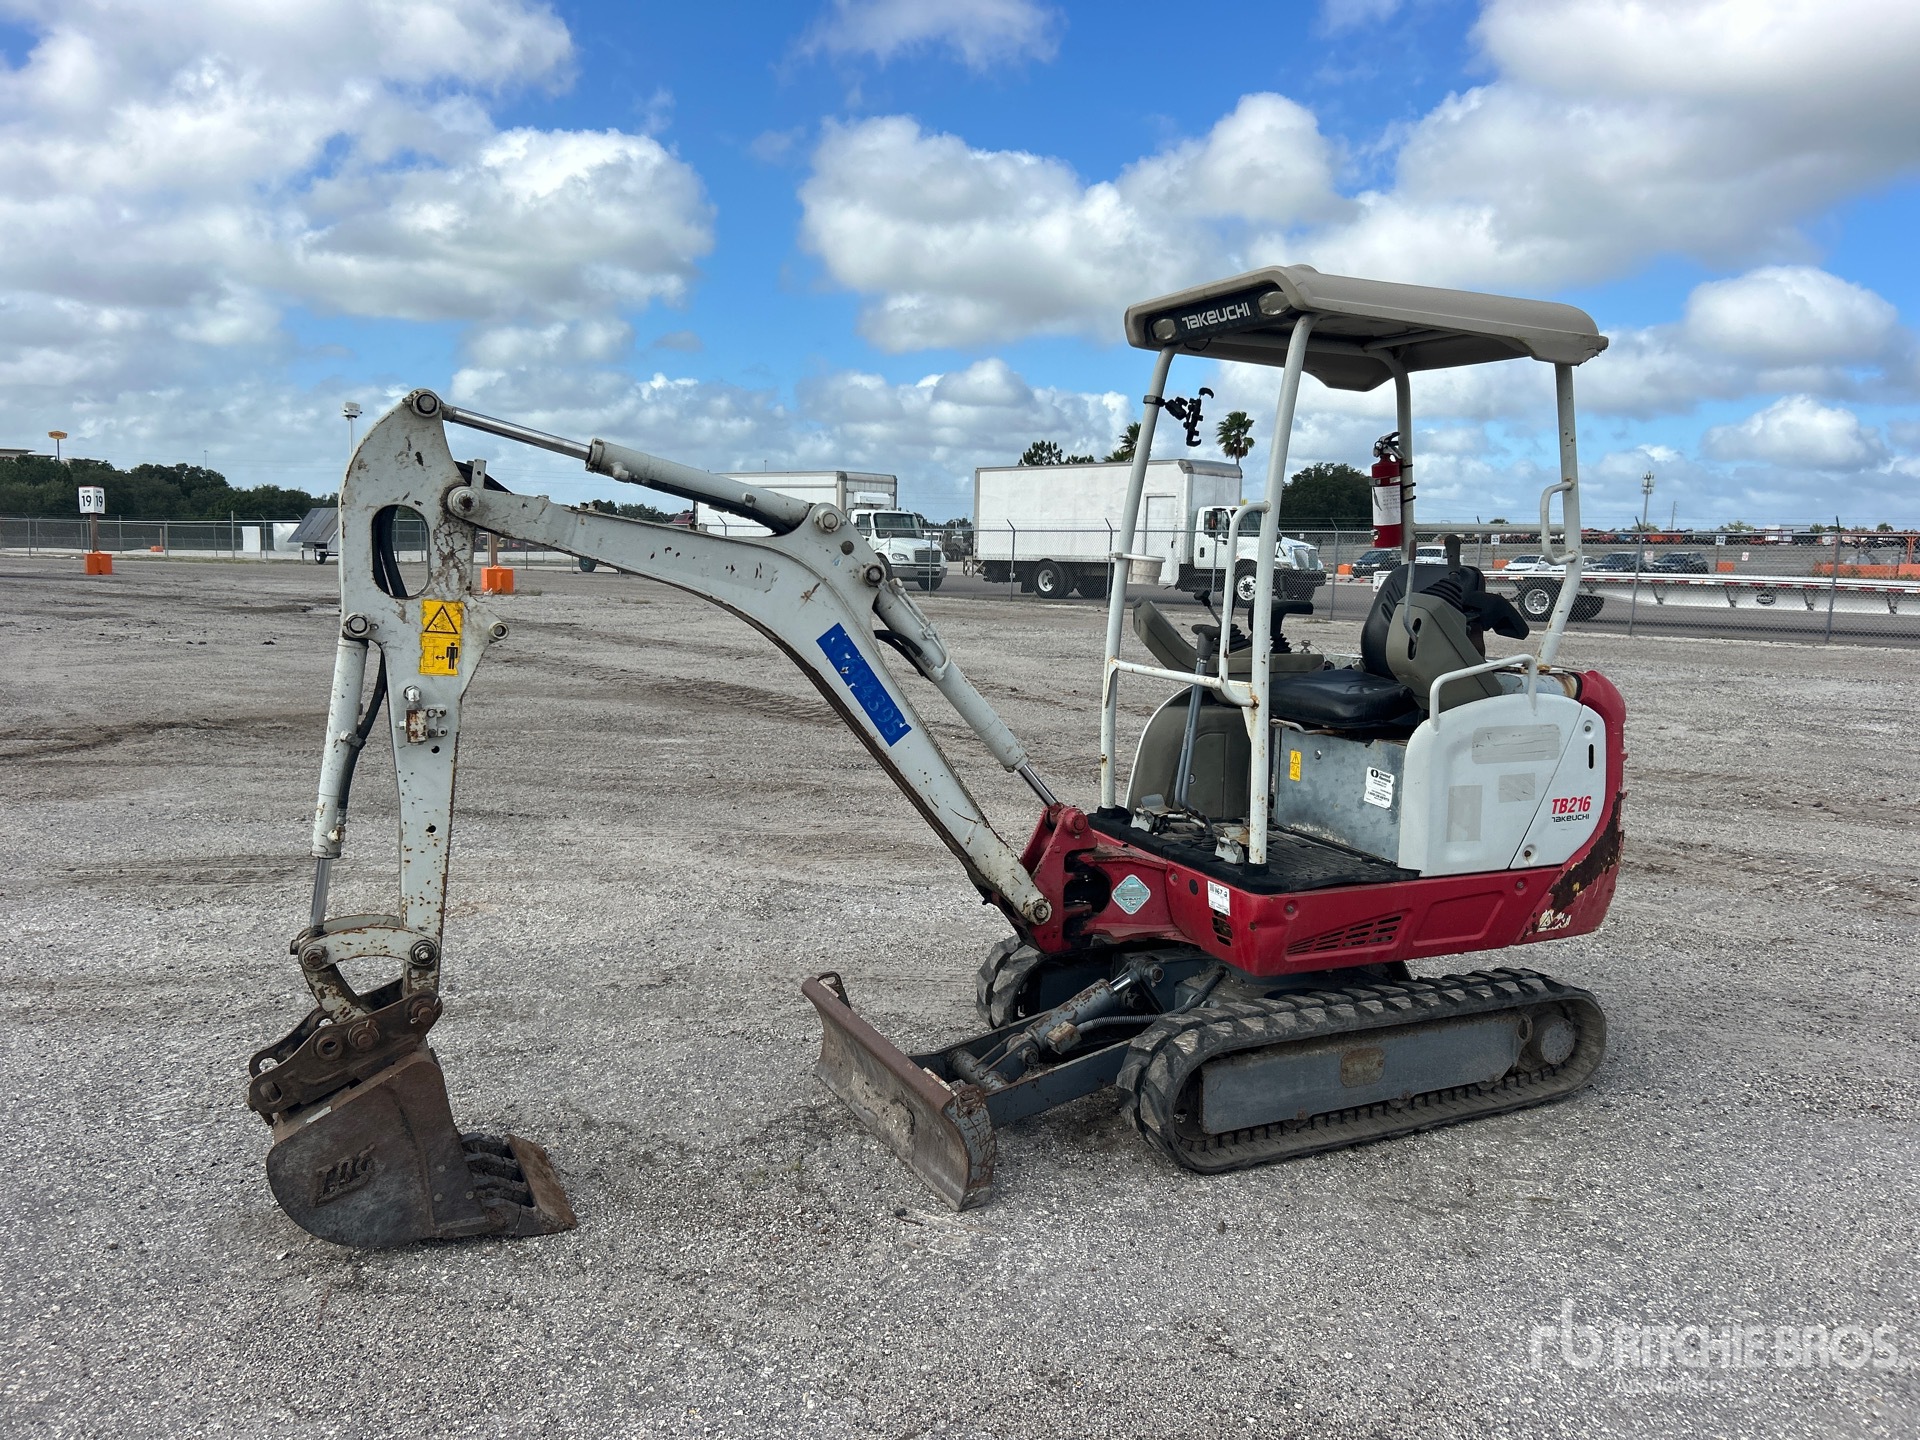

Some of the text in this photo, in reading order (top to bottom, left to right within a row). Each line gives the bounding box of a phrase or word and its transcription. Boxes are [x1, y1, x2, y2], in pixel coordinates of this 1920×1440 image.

[82, 495, 92, 507] 19
[95, 495, 103, 507] 19
[1552, 795, 1592, 815] TB216
